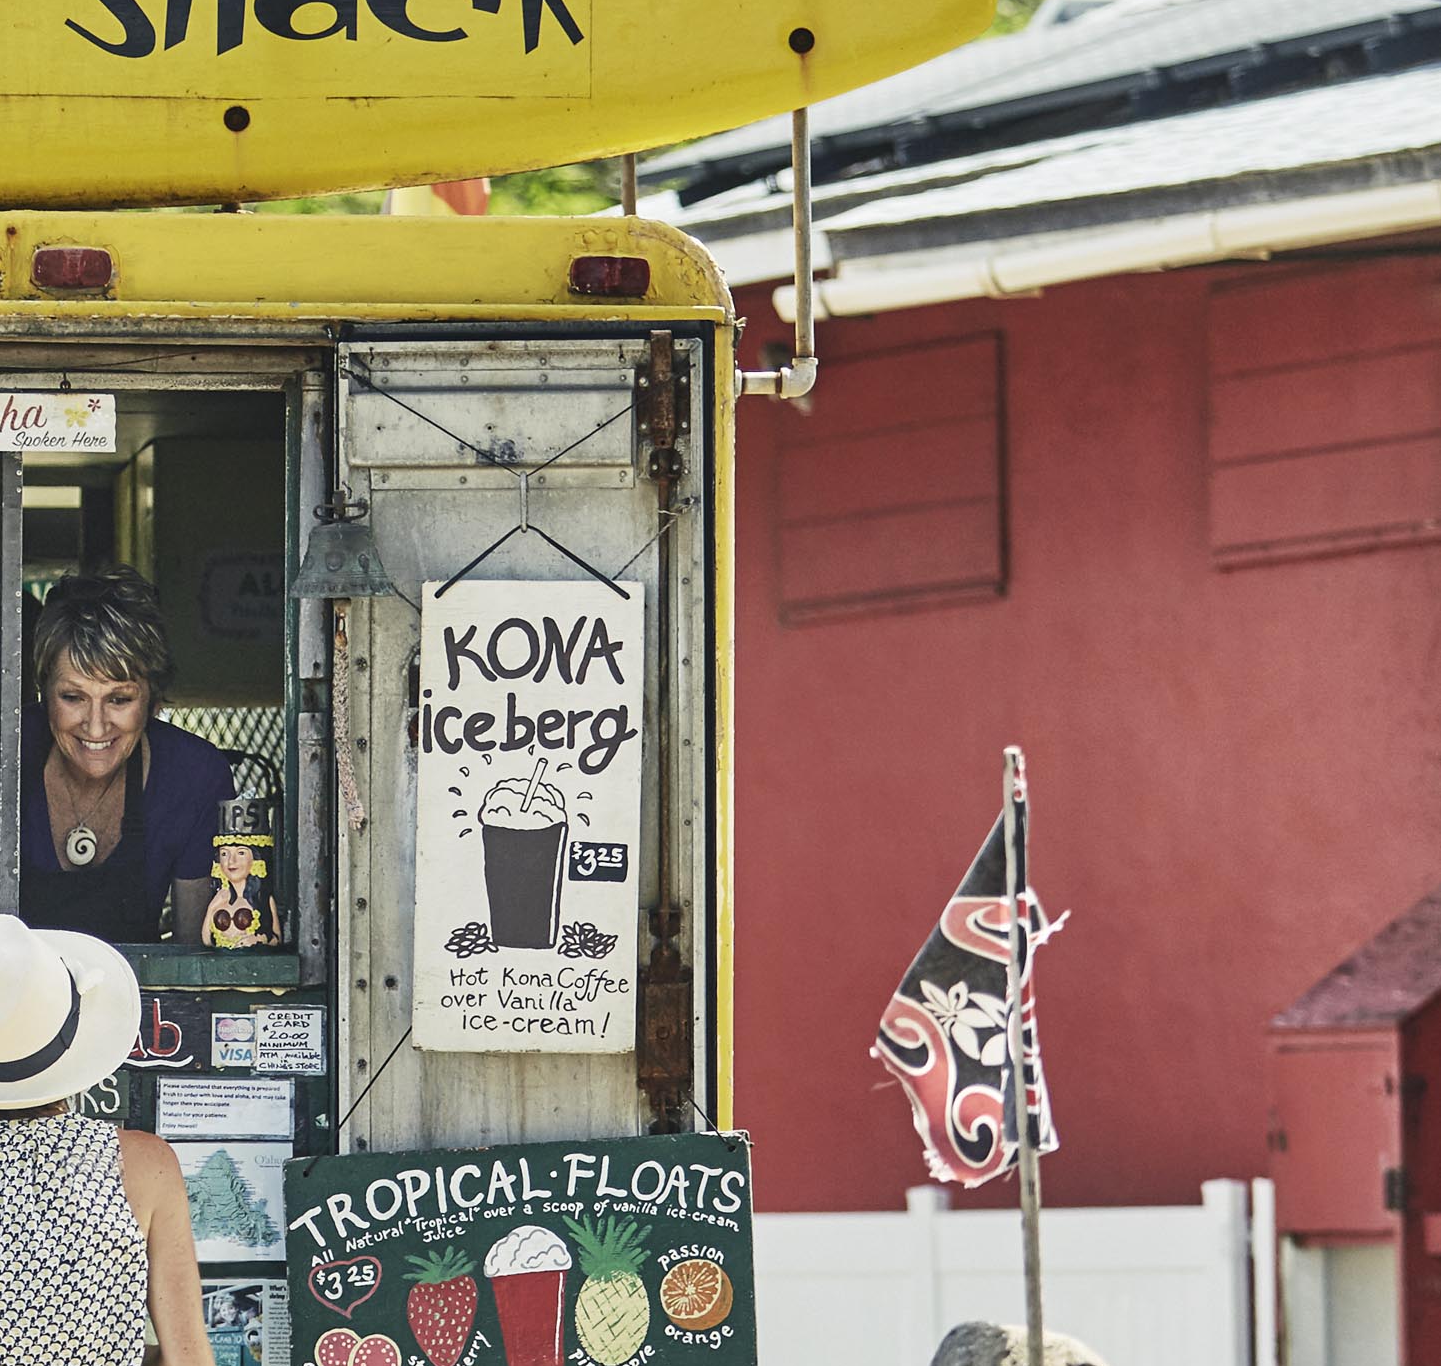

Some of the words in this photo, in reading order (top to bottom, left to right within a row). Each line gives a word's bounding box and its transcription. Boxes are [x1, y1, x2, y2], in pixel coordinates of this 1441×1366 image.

[12, 431, 67, 449] Spoken
[71, 432, 108, 447] Here
[443, 615, 625, 691] KONA
[450, 966, 489, 988] Hot
[501, 967, 554, 988] Kona
[556, 966, 631, 1003] Coffee
[440, 991, 487, 1010] over
[498, 988, 578, 1013] Vanilla
[219, 1049, 252, 1061] VISA
[311, 1250, 336, 1269] All
[345, 1224, 405, 1253] Natural
[483, 1204, 516, 1220] over
[524, 1203, 533, 1215] a
[542, 1201, 584, 1221] scoop
[593, 1200, 609, 1214] of
[613, 1199, 658, 1216] vanilla
[665, 1205, 740, 1232] ice-cream
[657, 1244, 725, 1270] passion
[663, 1324, 734, 1351] orange
